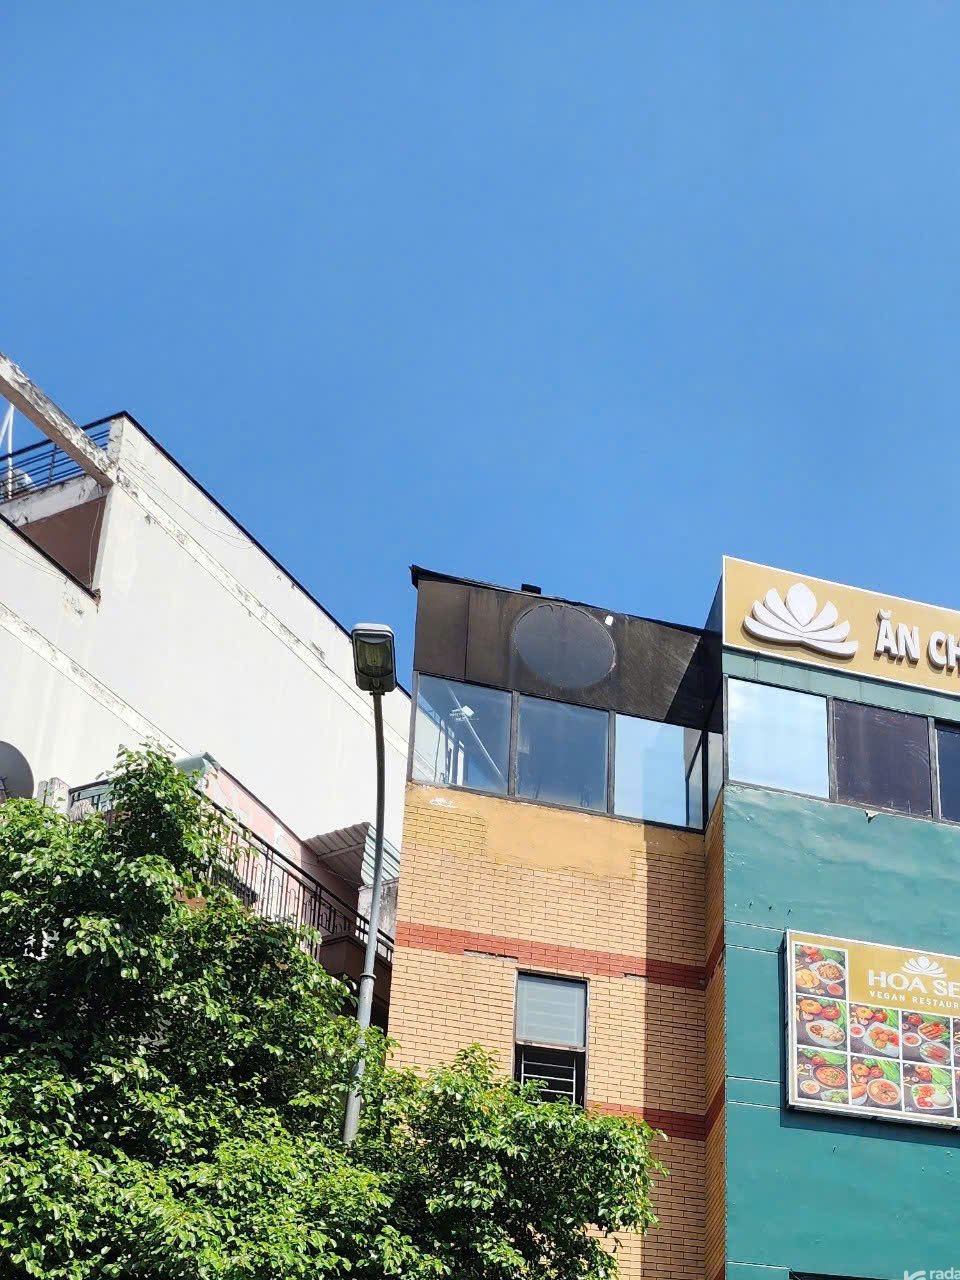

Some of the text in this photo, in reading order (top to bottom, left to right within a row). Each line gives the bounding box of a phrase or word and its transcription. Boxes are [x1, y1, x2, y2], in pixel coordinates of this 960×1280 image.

[876, 609, 920, 663] ĂN
[868, 969, 928, 994] HOA
[869, 990, 906, 1002] VEGAN
